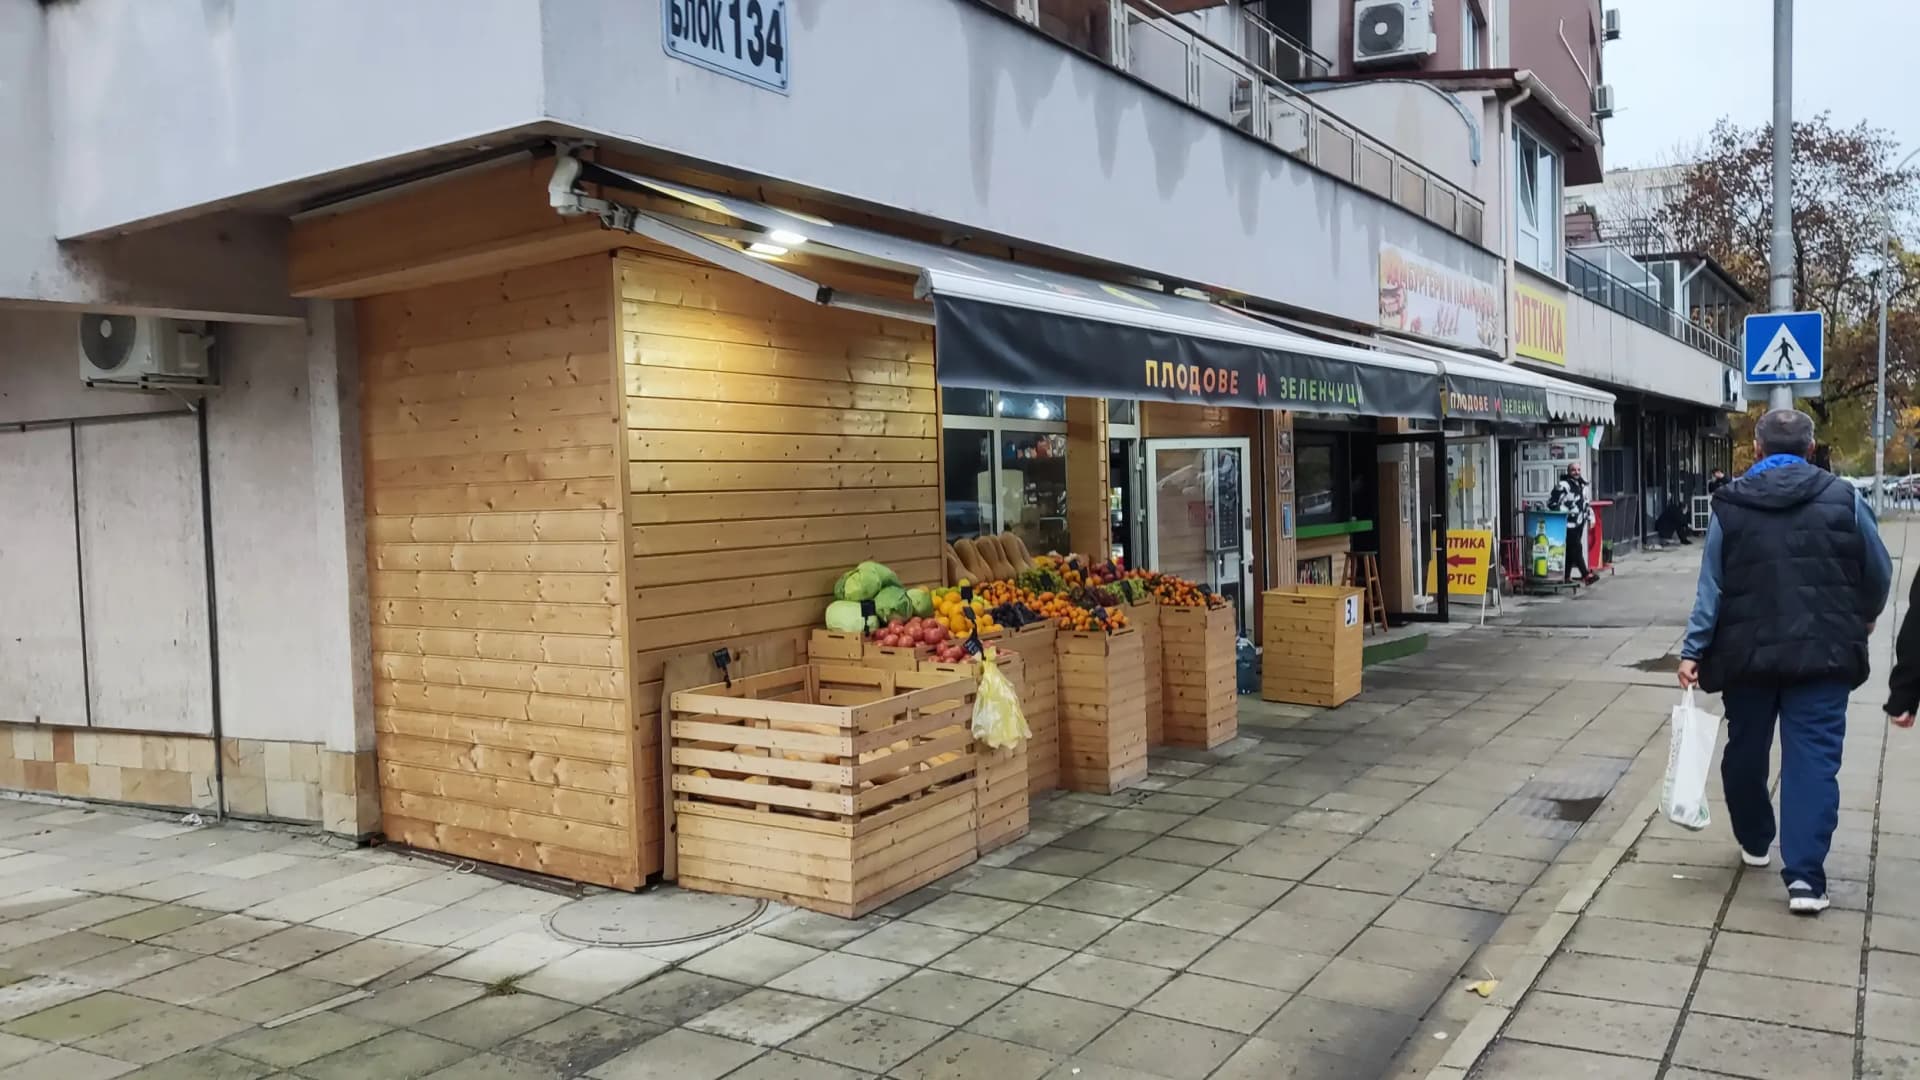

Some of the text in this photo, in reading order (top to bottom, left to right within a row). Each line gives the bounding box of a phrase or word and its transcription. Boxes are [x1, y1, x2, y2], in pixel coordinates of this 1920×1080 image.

[729, 0, 784, 73] 134
[1514, 290, 1564, 355] ОПТИКА
[1145, 359, 1364, 407] ПЛОДОВЕ И ЗЕЛЕНЧУЦИ
[1450, 391, 1489, 413] ПЛОДОВЕ
[1494, 397, 1501, 411] И
[1447, 537, 1485, 549] ПТИКА
[1447, 573, 1476, 585] PTIC
